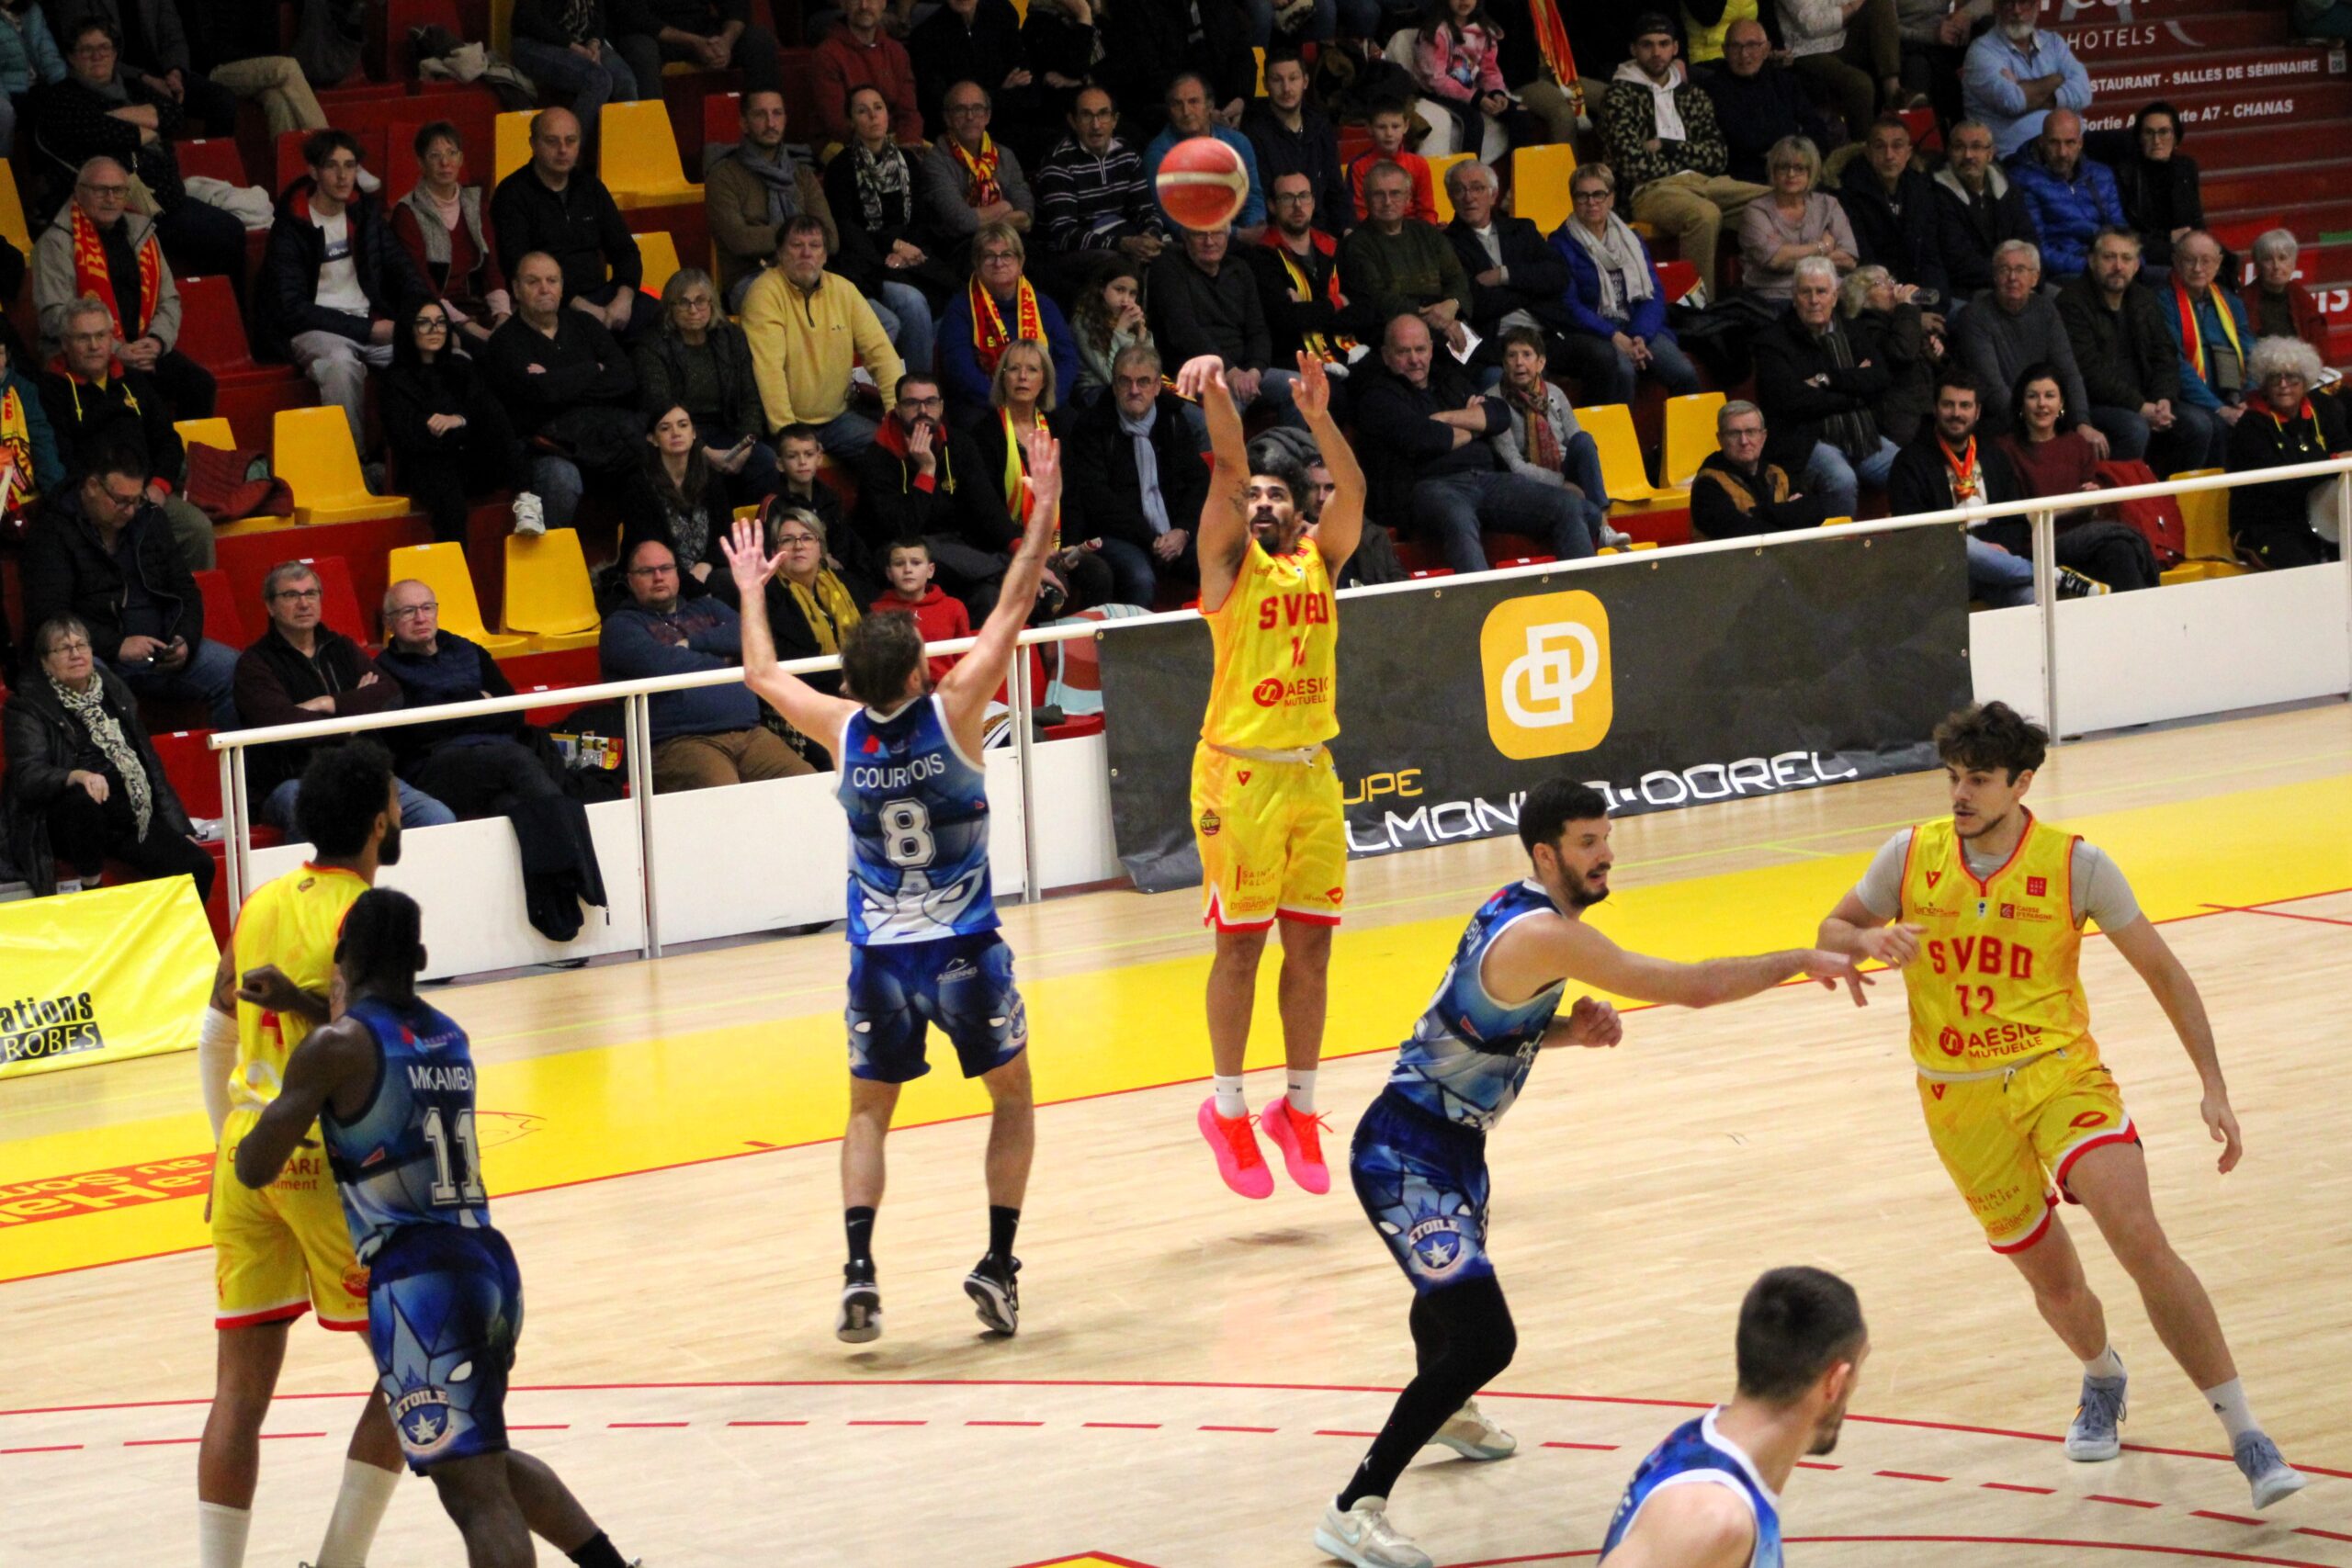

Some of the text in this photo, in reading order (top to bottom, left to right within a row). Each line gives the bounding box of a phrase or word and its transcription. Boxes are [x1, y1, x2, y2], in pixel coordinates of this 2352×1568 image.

[2067, 26, 2155, 51] HOTELS
[2173, 70, 2222, 85] SALLES
[2226, 66, 2244, 80] DE
[2247, 60, 2319, 78] SÉMINAIRE
[2201, 107, 2222, 121] A7
[2233, 99, 2293, 118] CHANAS
[2082, 116, 2121, 132] Sortie
[1284, 694, 1328, 706] MUTUELL
[853, 753, 945, 788] COURTOIS
[878, 797, 937, 871] 8
[1928, 935, 2033, 978] SVBD
[1969, 1036, 2042, 1058] MUTUELLE
[423, 1106, 486, 1206] 11
[395, 1390, 448, 1421] ETOILE
